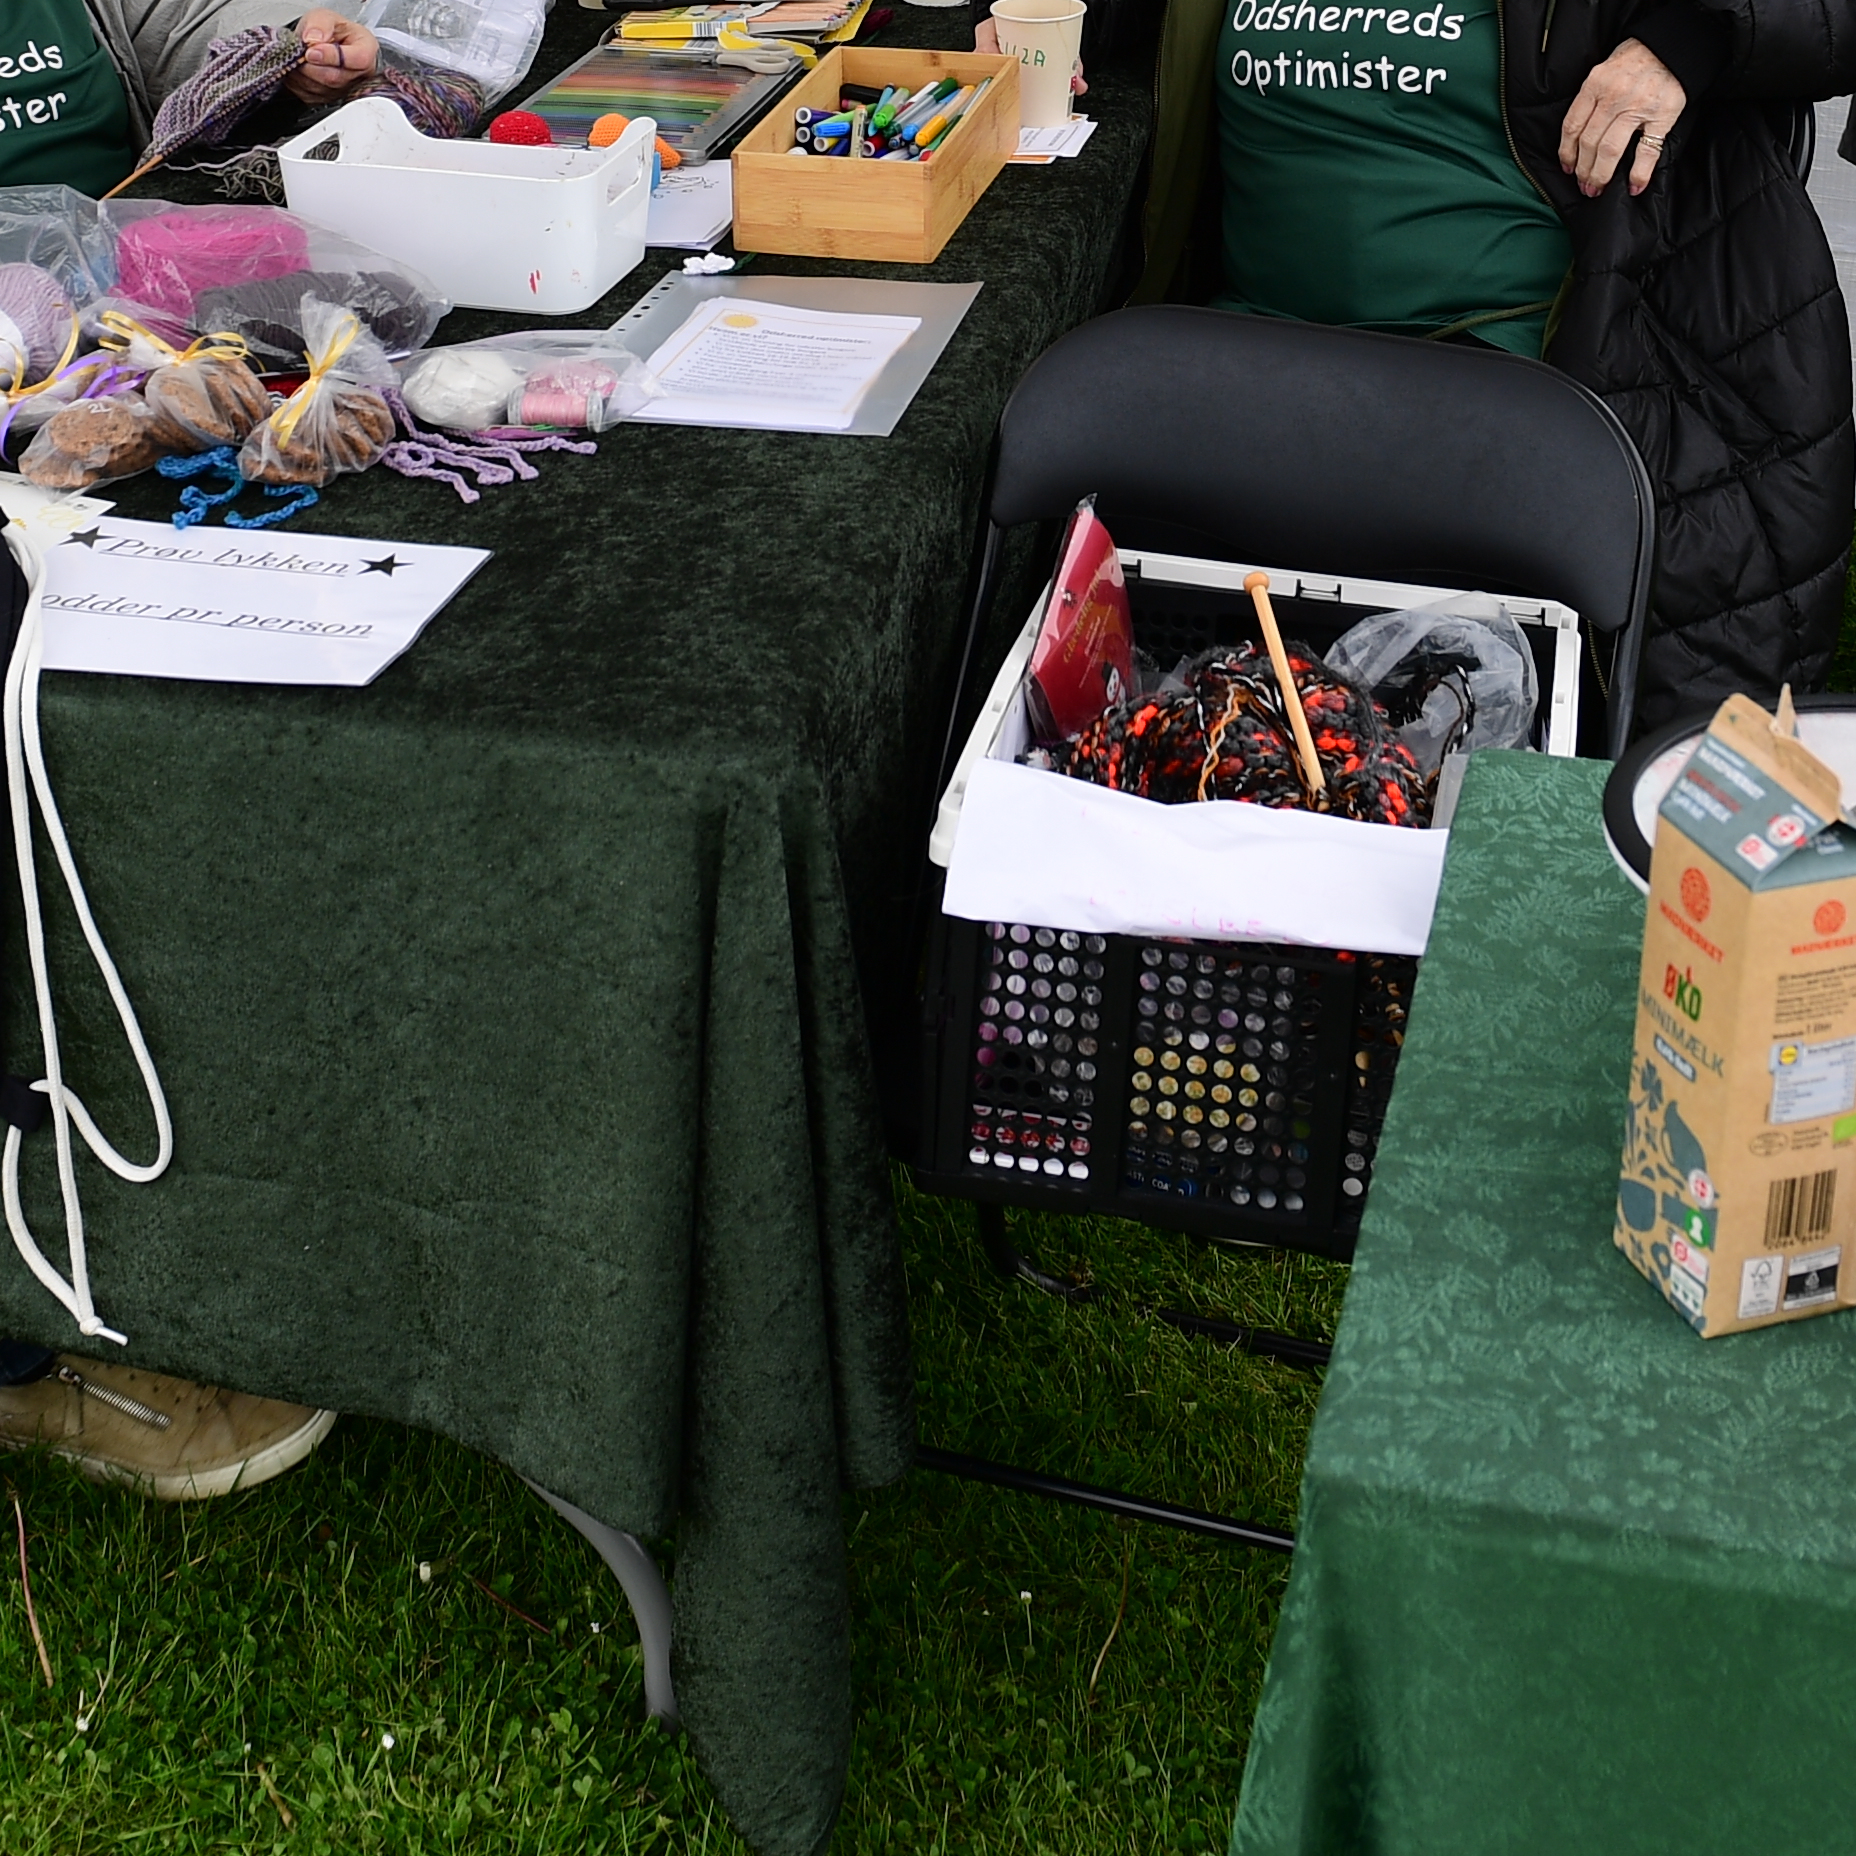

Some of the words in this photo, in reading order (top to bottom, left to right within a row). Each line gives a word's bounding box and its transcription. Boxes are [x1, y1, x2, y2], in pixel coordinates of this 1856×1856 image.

[1231, 50, 1447, 96] Optimister
[103, 536, 204, 563] Prøv
[217, 541, 349, 576] lykken
[40, 592, 163, 618] odder
[165, 606, 223, 625] pr
[224, 611, 374, 639] person
